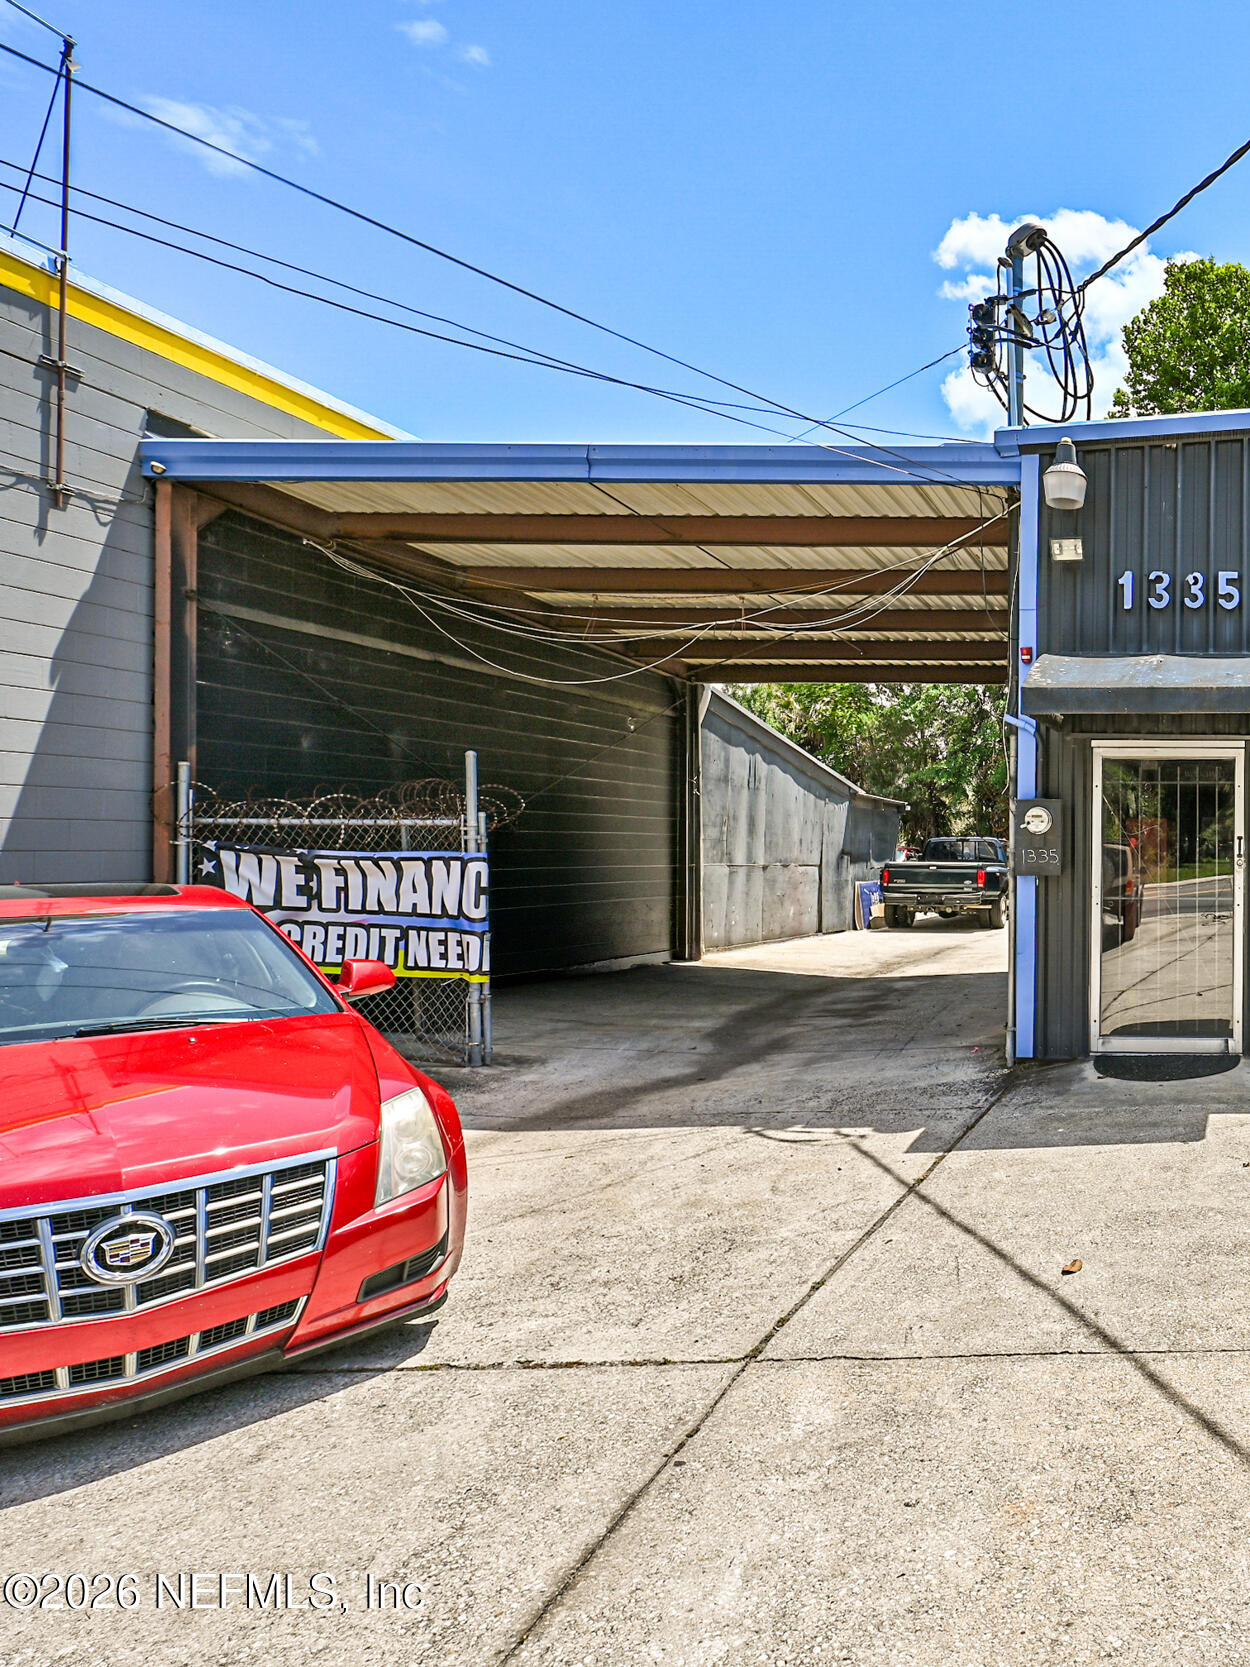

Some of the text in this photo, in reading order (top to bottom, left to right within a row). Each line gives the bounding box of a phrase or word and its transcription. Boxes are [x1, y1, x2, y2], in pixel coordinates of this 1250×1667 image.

[1118, 570, 1240, 610] 1335
[1021, 848, 1059, 865] 1335
[220, 850, 489, 919] WE FINANC
